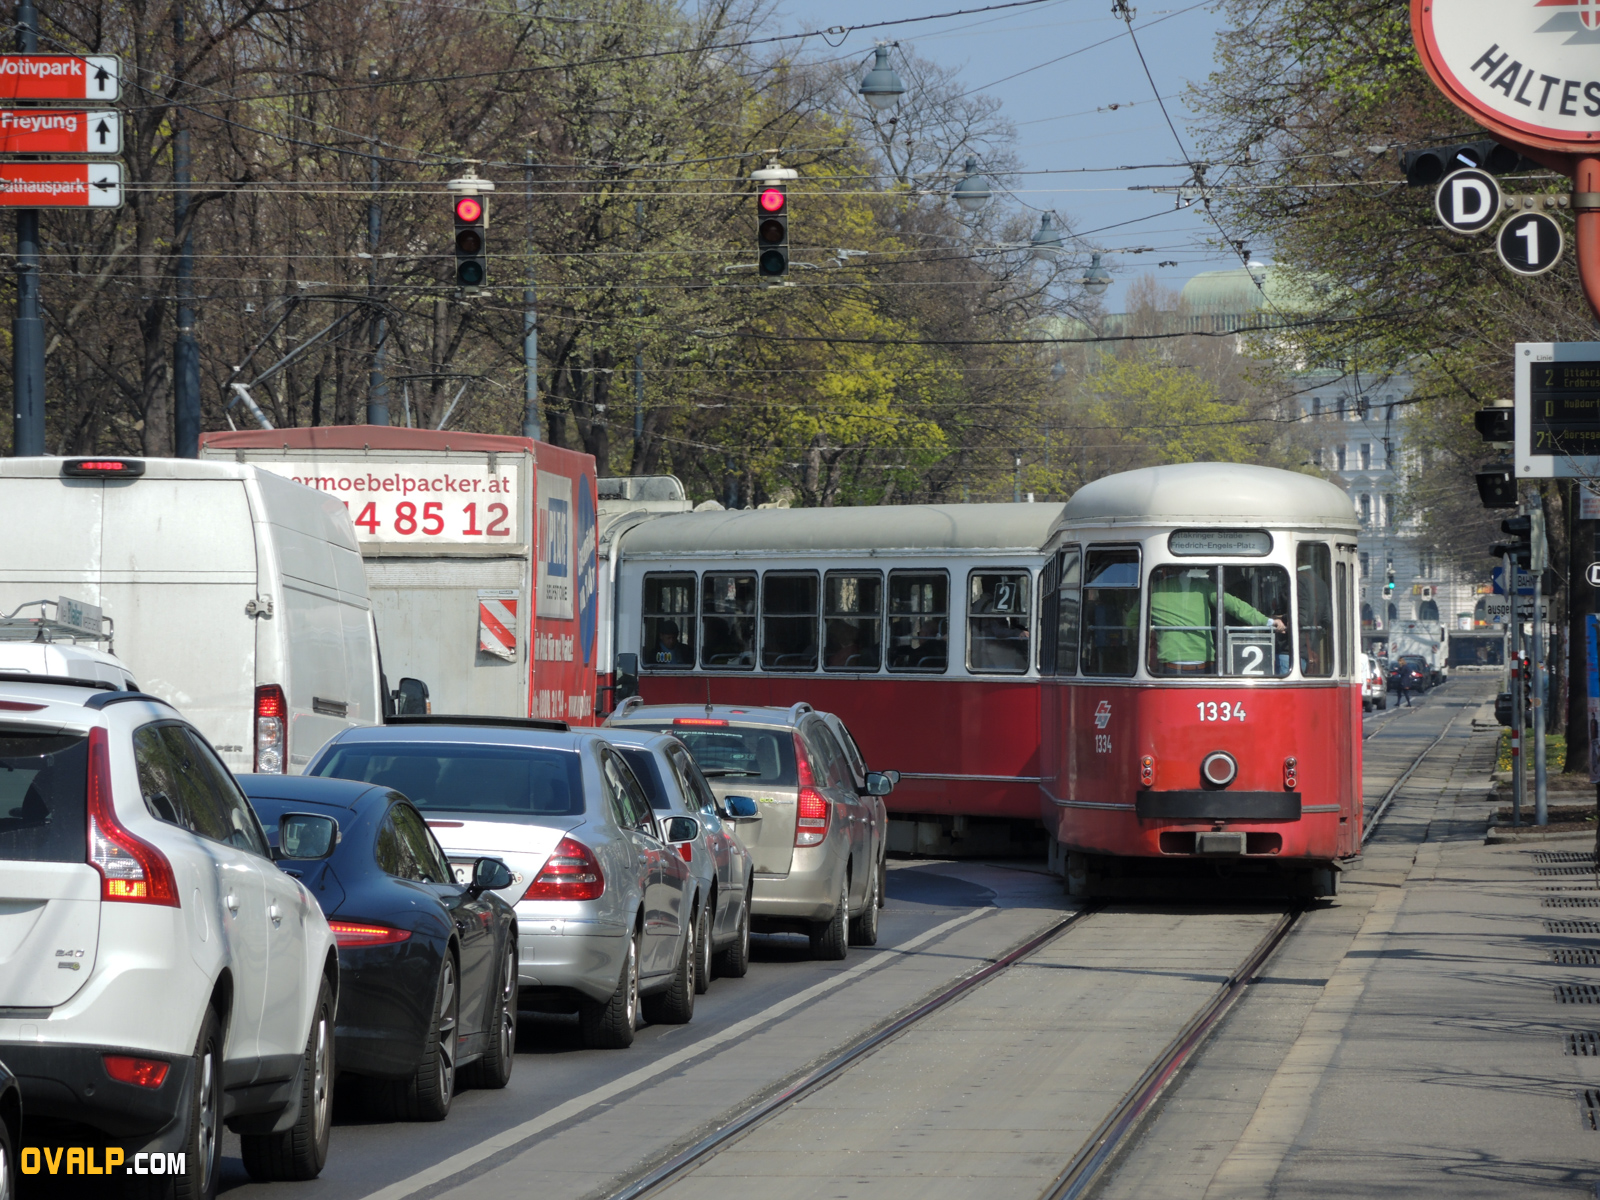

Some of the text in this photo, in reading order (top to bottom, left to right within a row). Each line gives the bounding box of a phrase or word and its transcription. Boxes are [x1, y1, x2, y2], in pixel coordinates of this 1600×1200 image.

[1469, 43, 1600, 118] HALTES
[2, 112, 77, 132] Freyung
[0, 178, 86, 196] athauspark
[1452, 178, 1491, 224] D
[1515, 221, 1539, 265] 1
[1545, 369, 1554, 386] 2
[394, 501, 445, 535] 85
[462, 502, 510, 537] 12
[1170, 541, 1256, 550] Friedrich-Engels-Platz
[997, 585, 1010, 610] 2
[1241, 645, 1264, 675] 2
[1196, 701, 1247, 722] 1334
[1095, 734, 1112, 753] 1334
